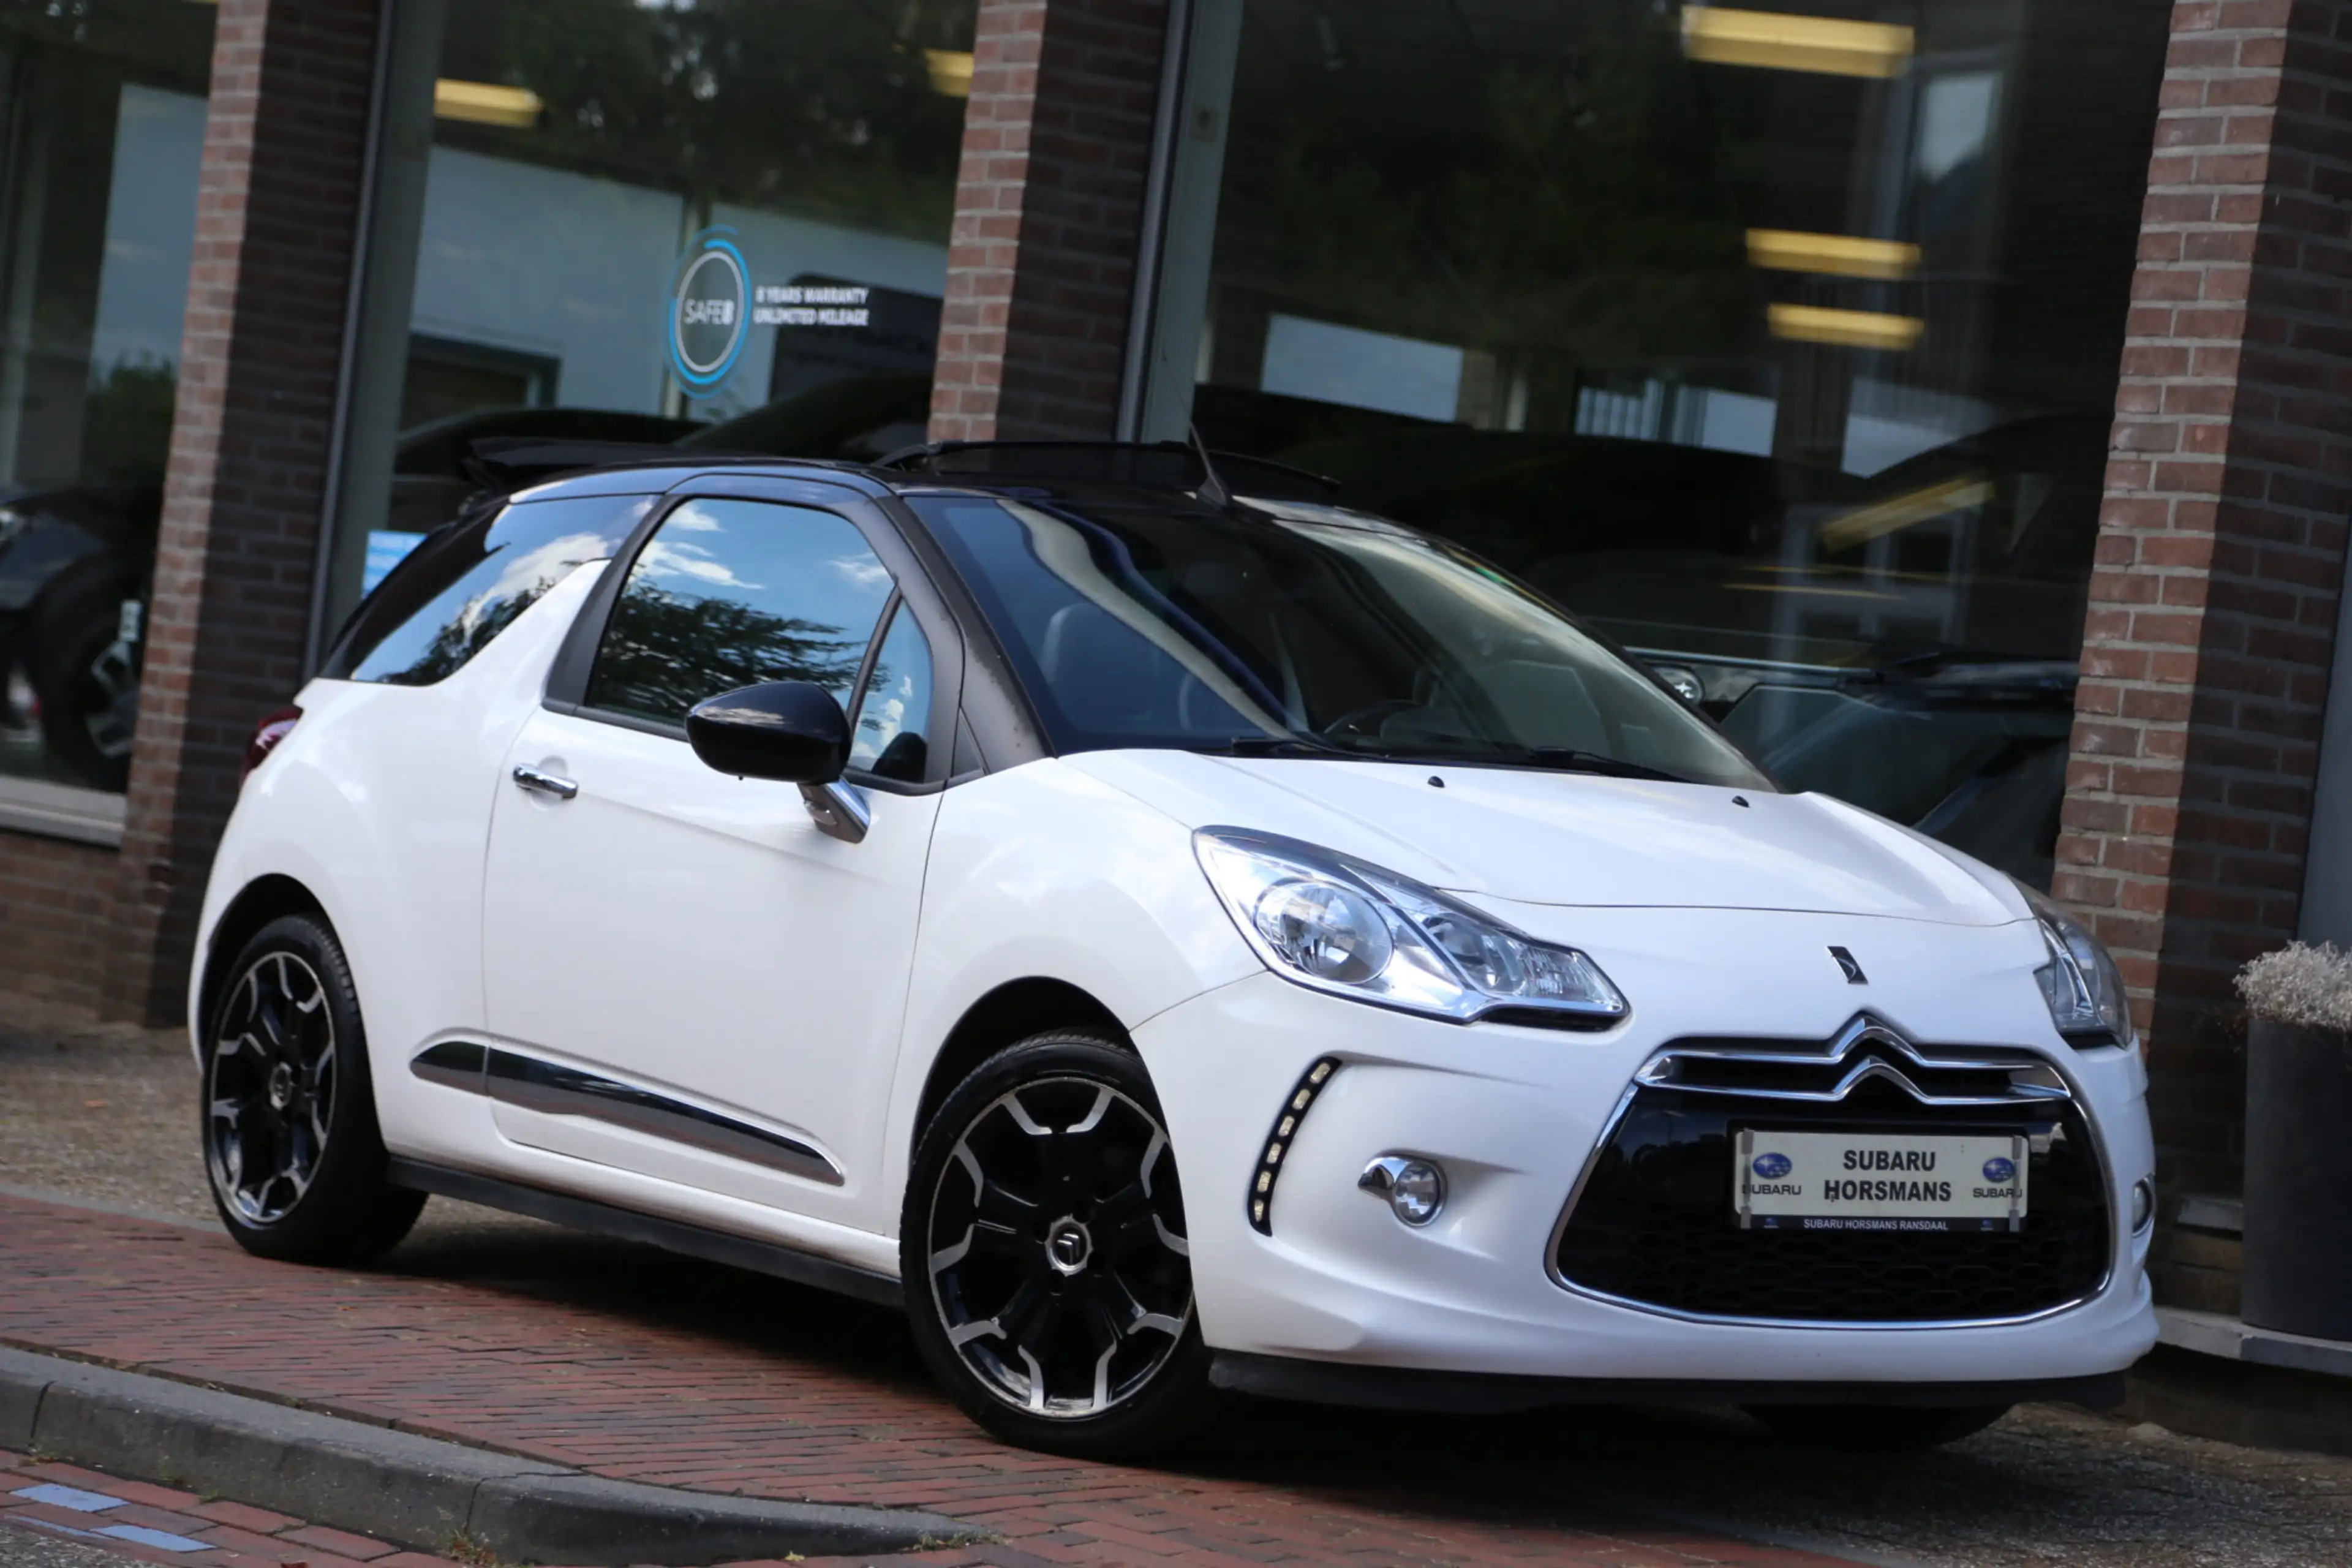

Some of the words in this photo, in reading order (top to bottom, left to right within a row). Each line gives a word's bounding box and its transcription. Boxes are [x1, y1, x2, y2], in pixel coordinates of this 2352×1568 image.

[767, 287, 802, 304] YEARS
[804, 287, 869, 304] WARRANTY
[753, 307, 817, 325] UNLIMITED
[818, 309, 869, 326] MILEAGE
[1843, 1150, 1936, 1172] SUBARU
[1824, 1180, 1951, 1202] HORSMANS
[1804, 1218, 1844, 1229] SUBARU
[1845, 1219, 1898, 1230] HORSMANS
[1899, 1221, 1948, 1231] RANSDAAL
